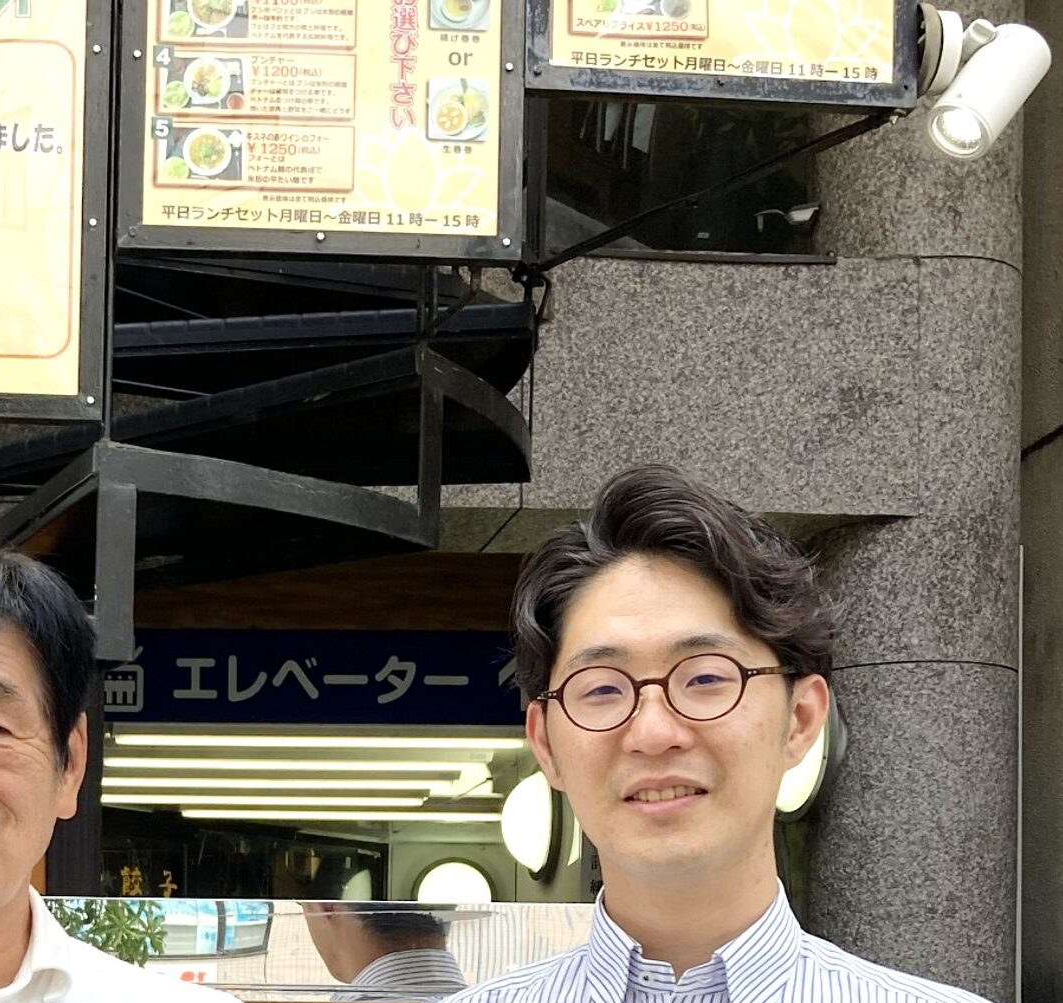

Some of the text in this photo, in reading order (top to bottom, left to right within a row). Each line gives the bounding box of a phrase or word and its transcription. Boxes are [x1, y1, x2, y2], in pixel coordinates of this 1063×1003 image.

[155, 48, 170, 66] 4
[390, 0, 418, 129] 選び下さい
[448, 51, 473, 66] or
[154, 119, 169, 136] 5
[173, 655, 469, 704] エレベーター
